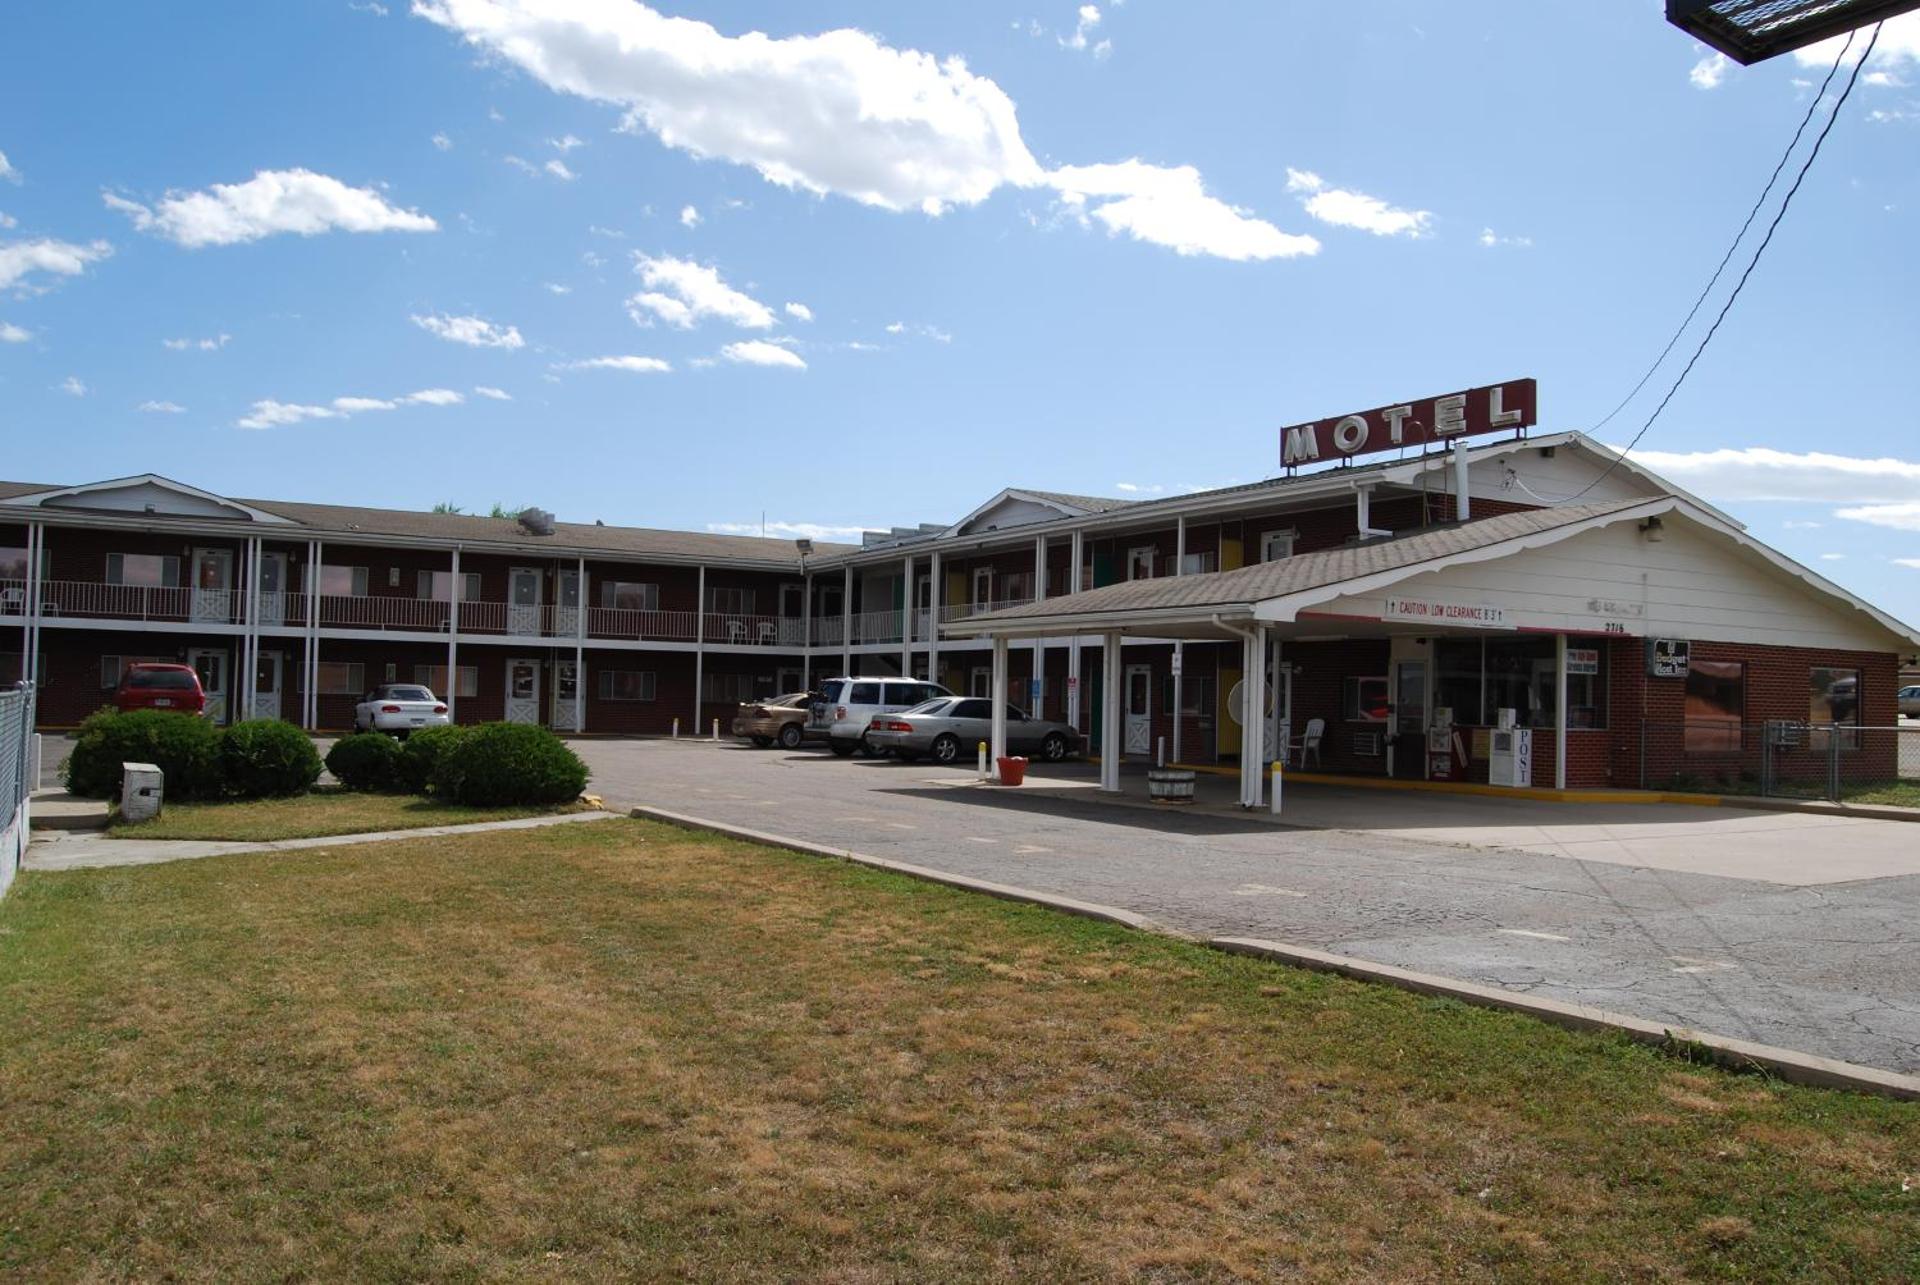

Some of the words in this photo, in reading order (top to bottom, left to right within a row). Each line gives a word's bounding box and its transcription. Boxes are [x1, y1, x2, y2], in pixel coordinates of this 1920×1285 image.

[1284, 386, 1522, 464] MOTEL
[1400, 601, 1428, 616] CAUTION
[1431, 604, 1445, 617] LOW
[1446, 605, 1482, 620] CLEARANCE
[1656, 652, 1687, 665] Budget
[1675, 664, 1689, 674] Inn
[1519, 730, 1529, 783] POST
